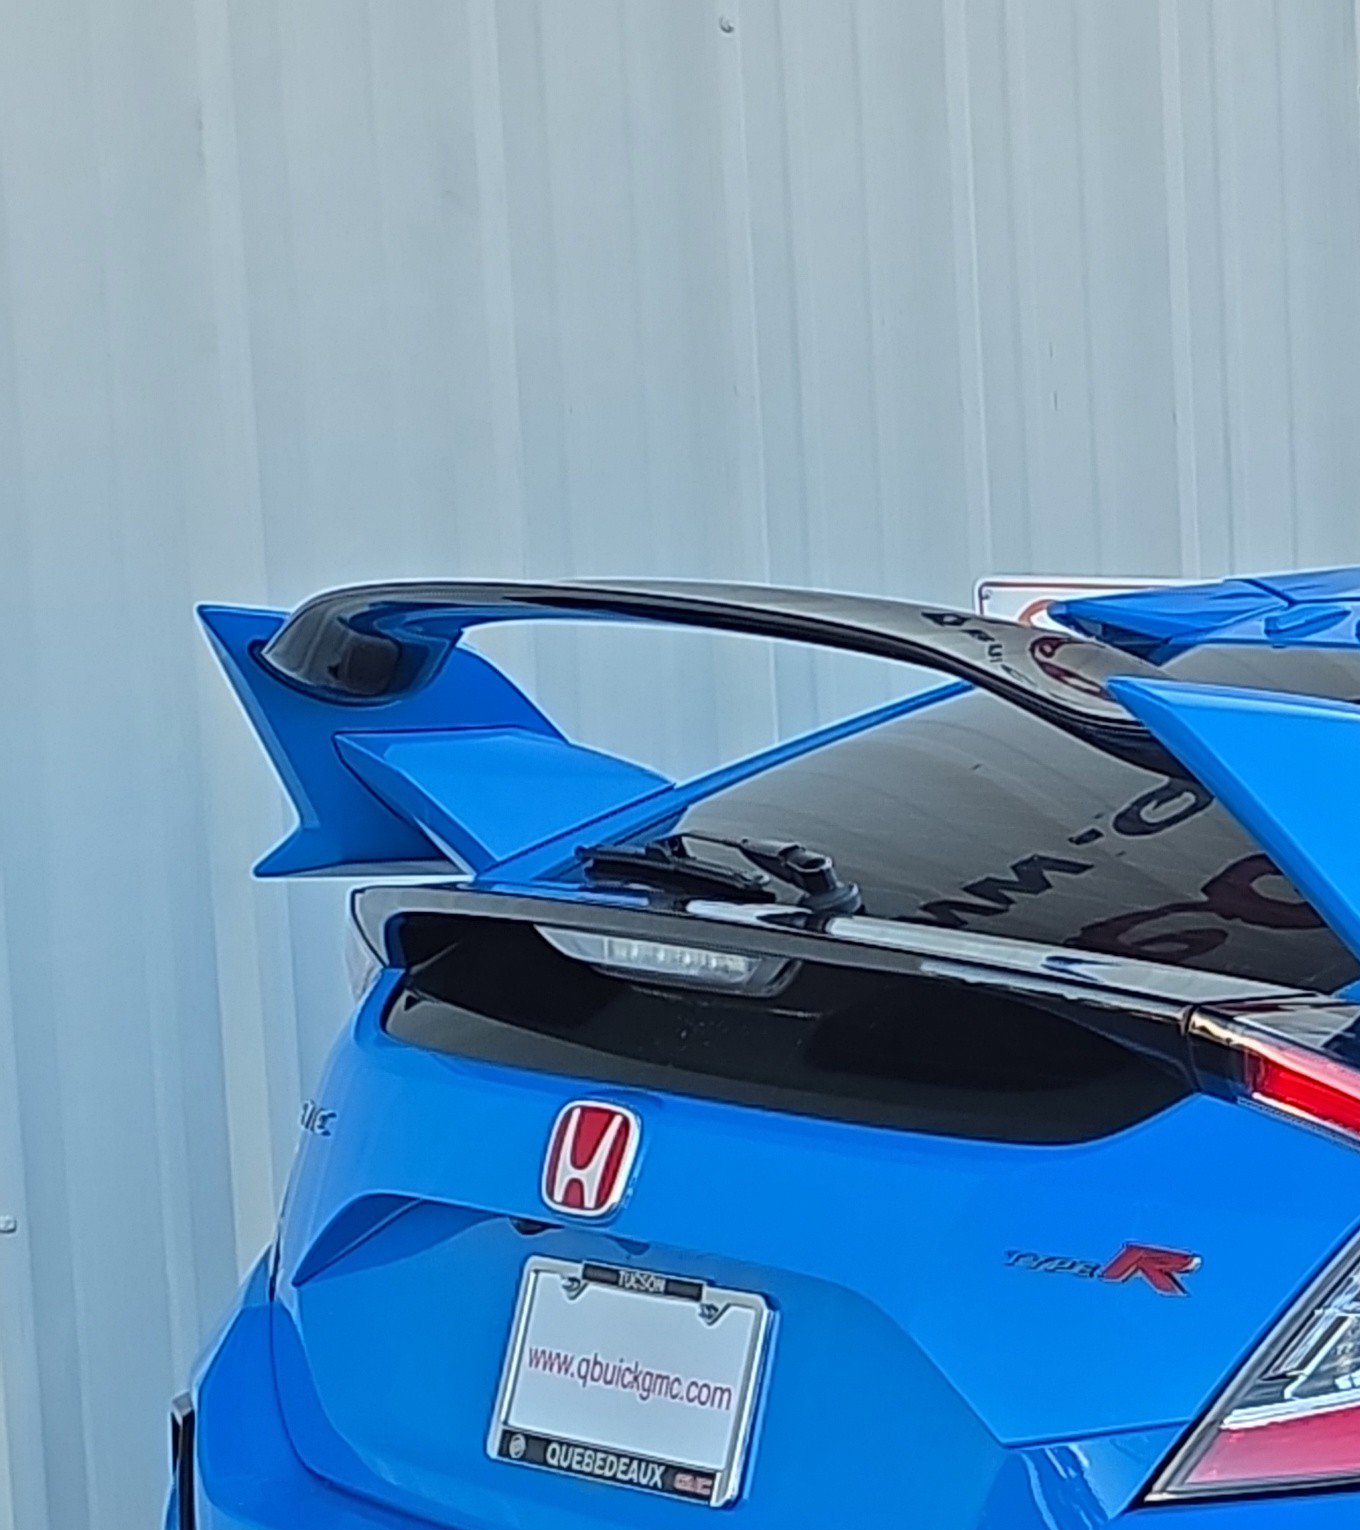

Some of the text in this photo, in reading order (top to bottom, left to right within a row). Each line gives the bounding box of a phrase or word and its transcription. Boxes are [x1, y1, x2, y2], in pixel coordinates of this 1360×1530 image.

[616, 1269, 667, 1293] TUCSON
[1099, 1240, 1203, 1297] R
[527, 1345, 733, 1411] www.qbuickgmc.com
[545, 1442, 667, 1489] QUEBEDEAUX
